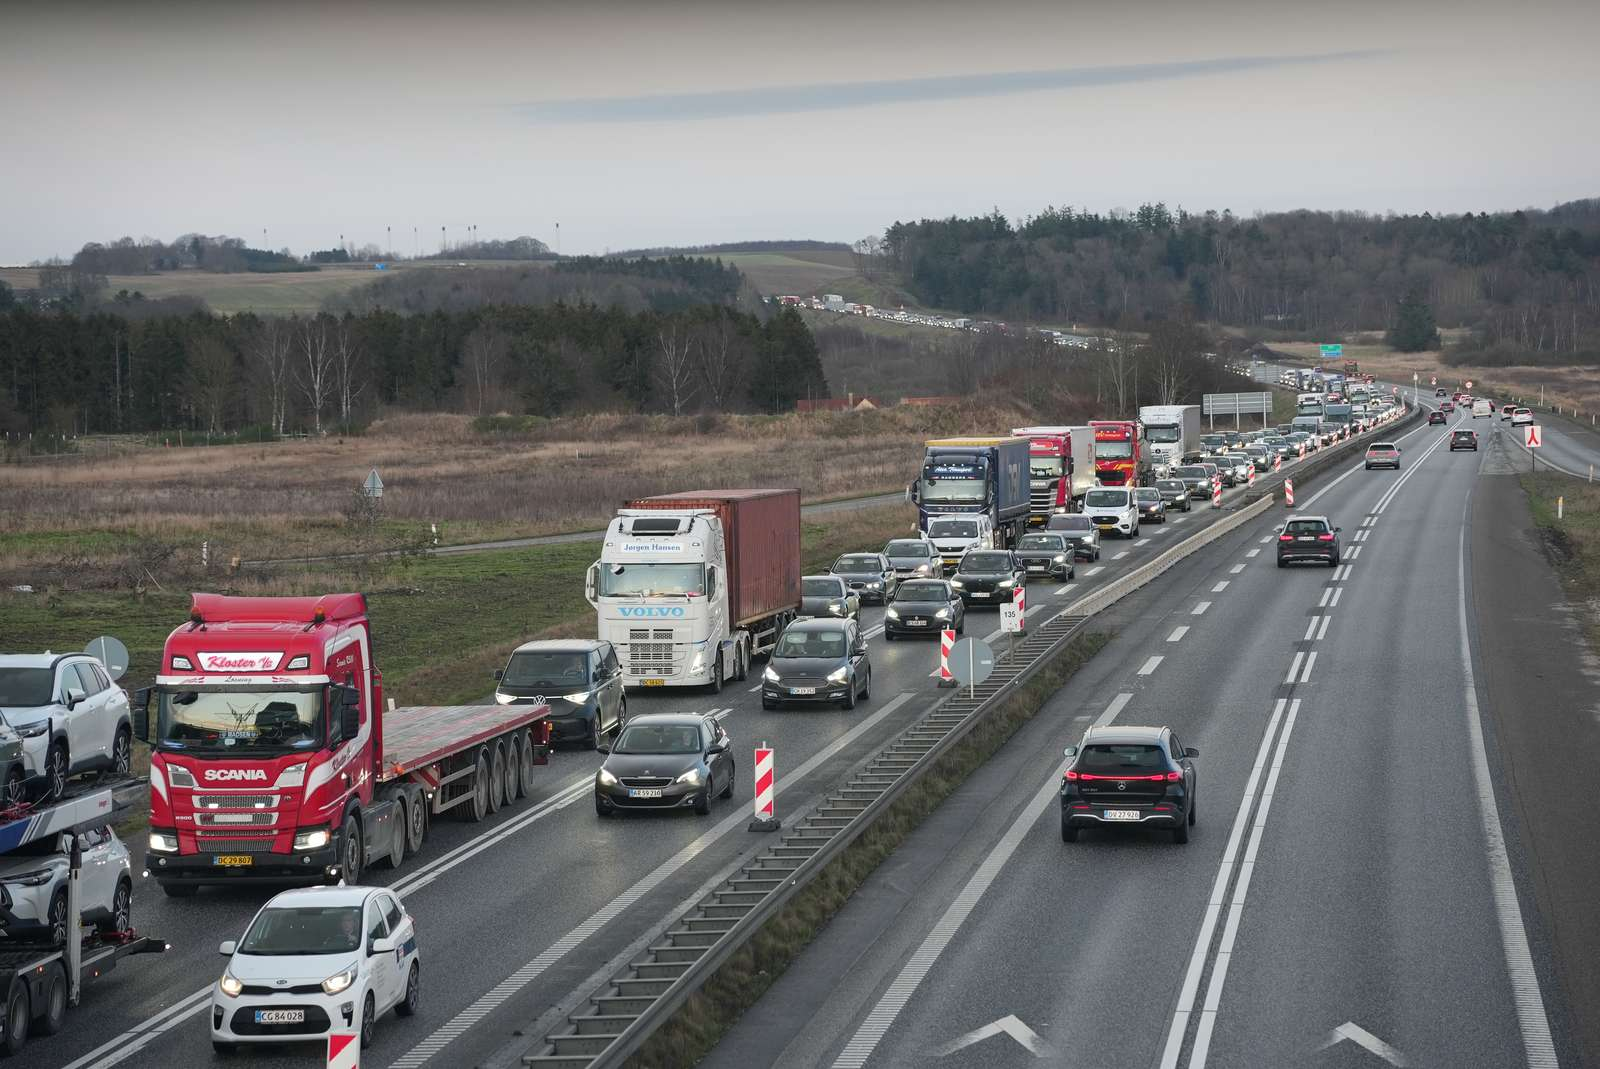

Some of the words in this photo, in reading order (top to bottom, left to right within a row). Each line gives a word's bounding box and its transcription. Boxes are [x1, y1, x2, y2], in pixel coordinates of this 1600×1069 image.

[624, 544, 650, 552] Jørgen
[617, 607, 685, 617] VOLVO
[1004, 610, 1016, 618] 135
[207, 655, 256, 669] Kloster
[204, 769, 268, 781] SCANIA
[261, 1011, 273, 1021] CG
[274, 1011, 286, 1021] 84
[286, 1011, 303, 1021] 028
